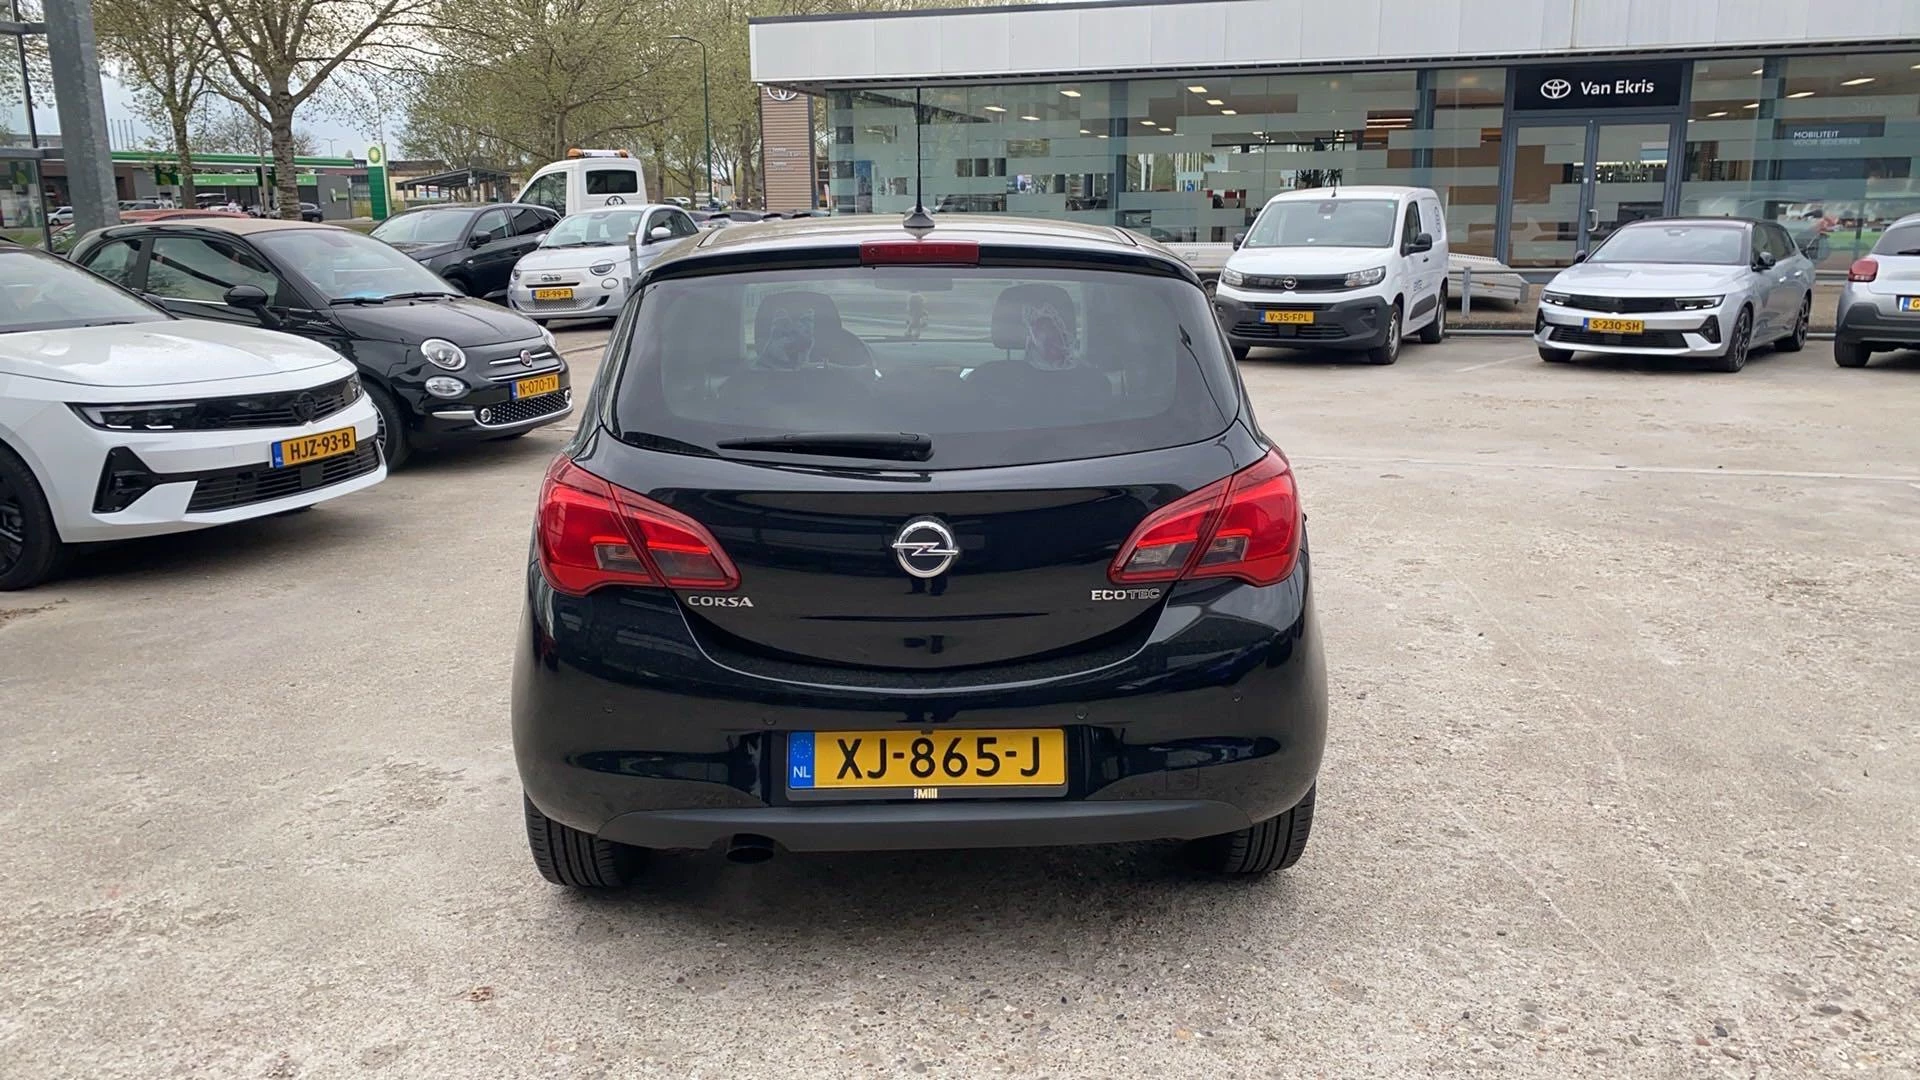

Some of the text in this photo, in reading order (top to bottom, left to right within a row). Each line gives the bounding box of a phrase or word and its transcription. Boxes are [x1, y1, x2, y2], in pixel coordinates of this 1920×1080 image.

[1580, 79, 1655, 95] Van Ekris
[1793, 130, 1840, 139] MOBILITEIT
[1269, 312, 1310, 322] V-35-FPL
[1592, 319, 1640, 331] S-230-SH
[519, 375, 556, 396] N-070-TV
[290, 432, 351, 460] HJZ-93-B
[1091, 588, 1161, 601] ECOTEC
[688, 595, 754, 608] CORSA
[793, 736, 1041, 779] NL XJ-865-J
[917, 787, 938, 799] Mill
